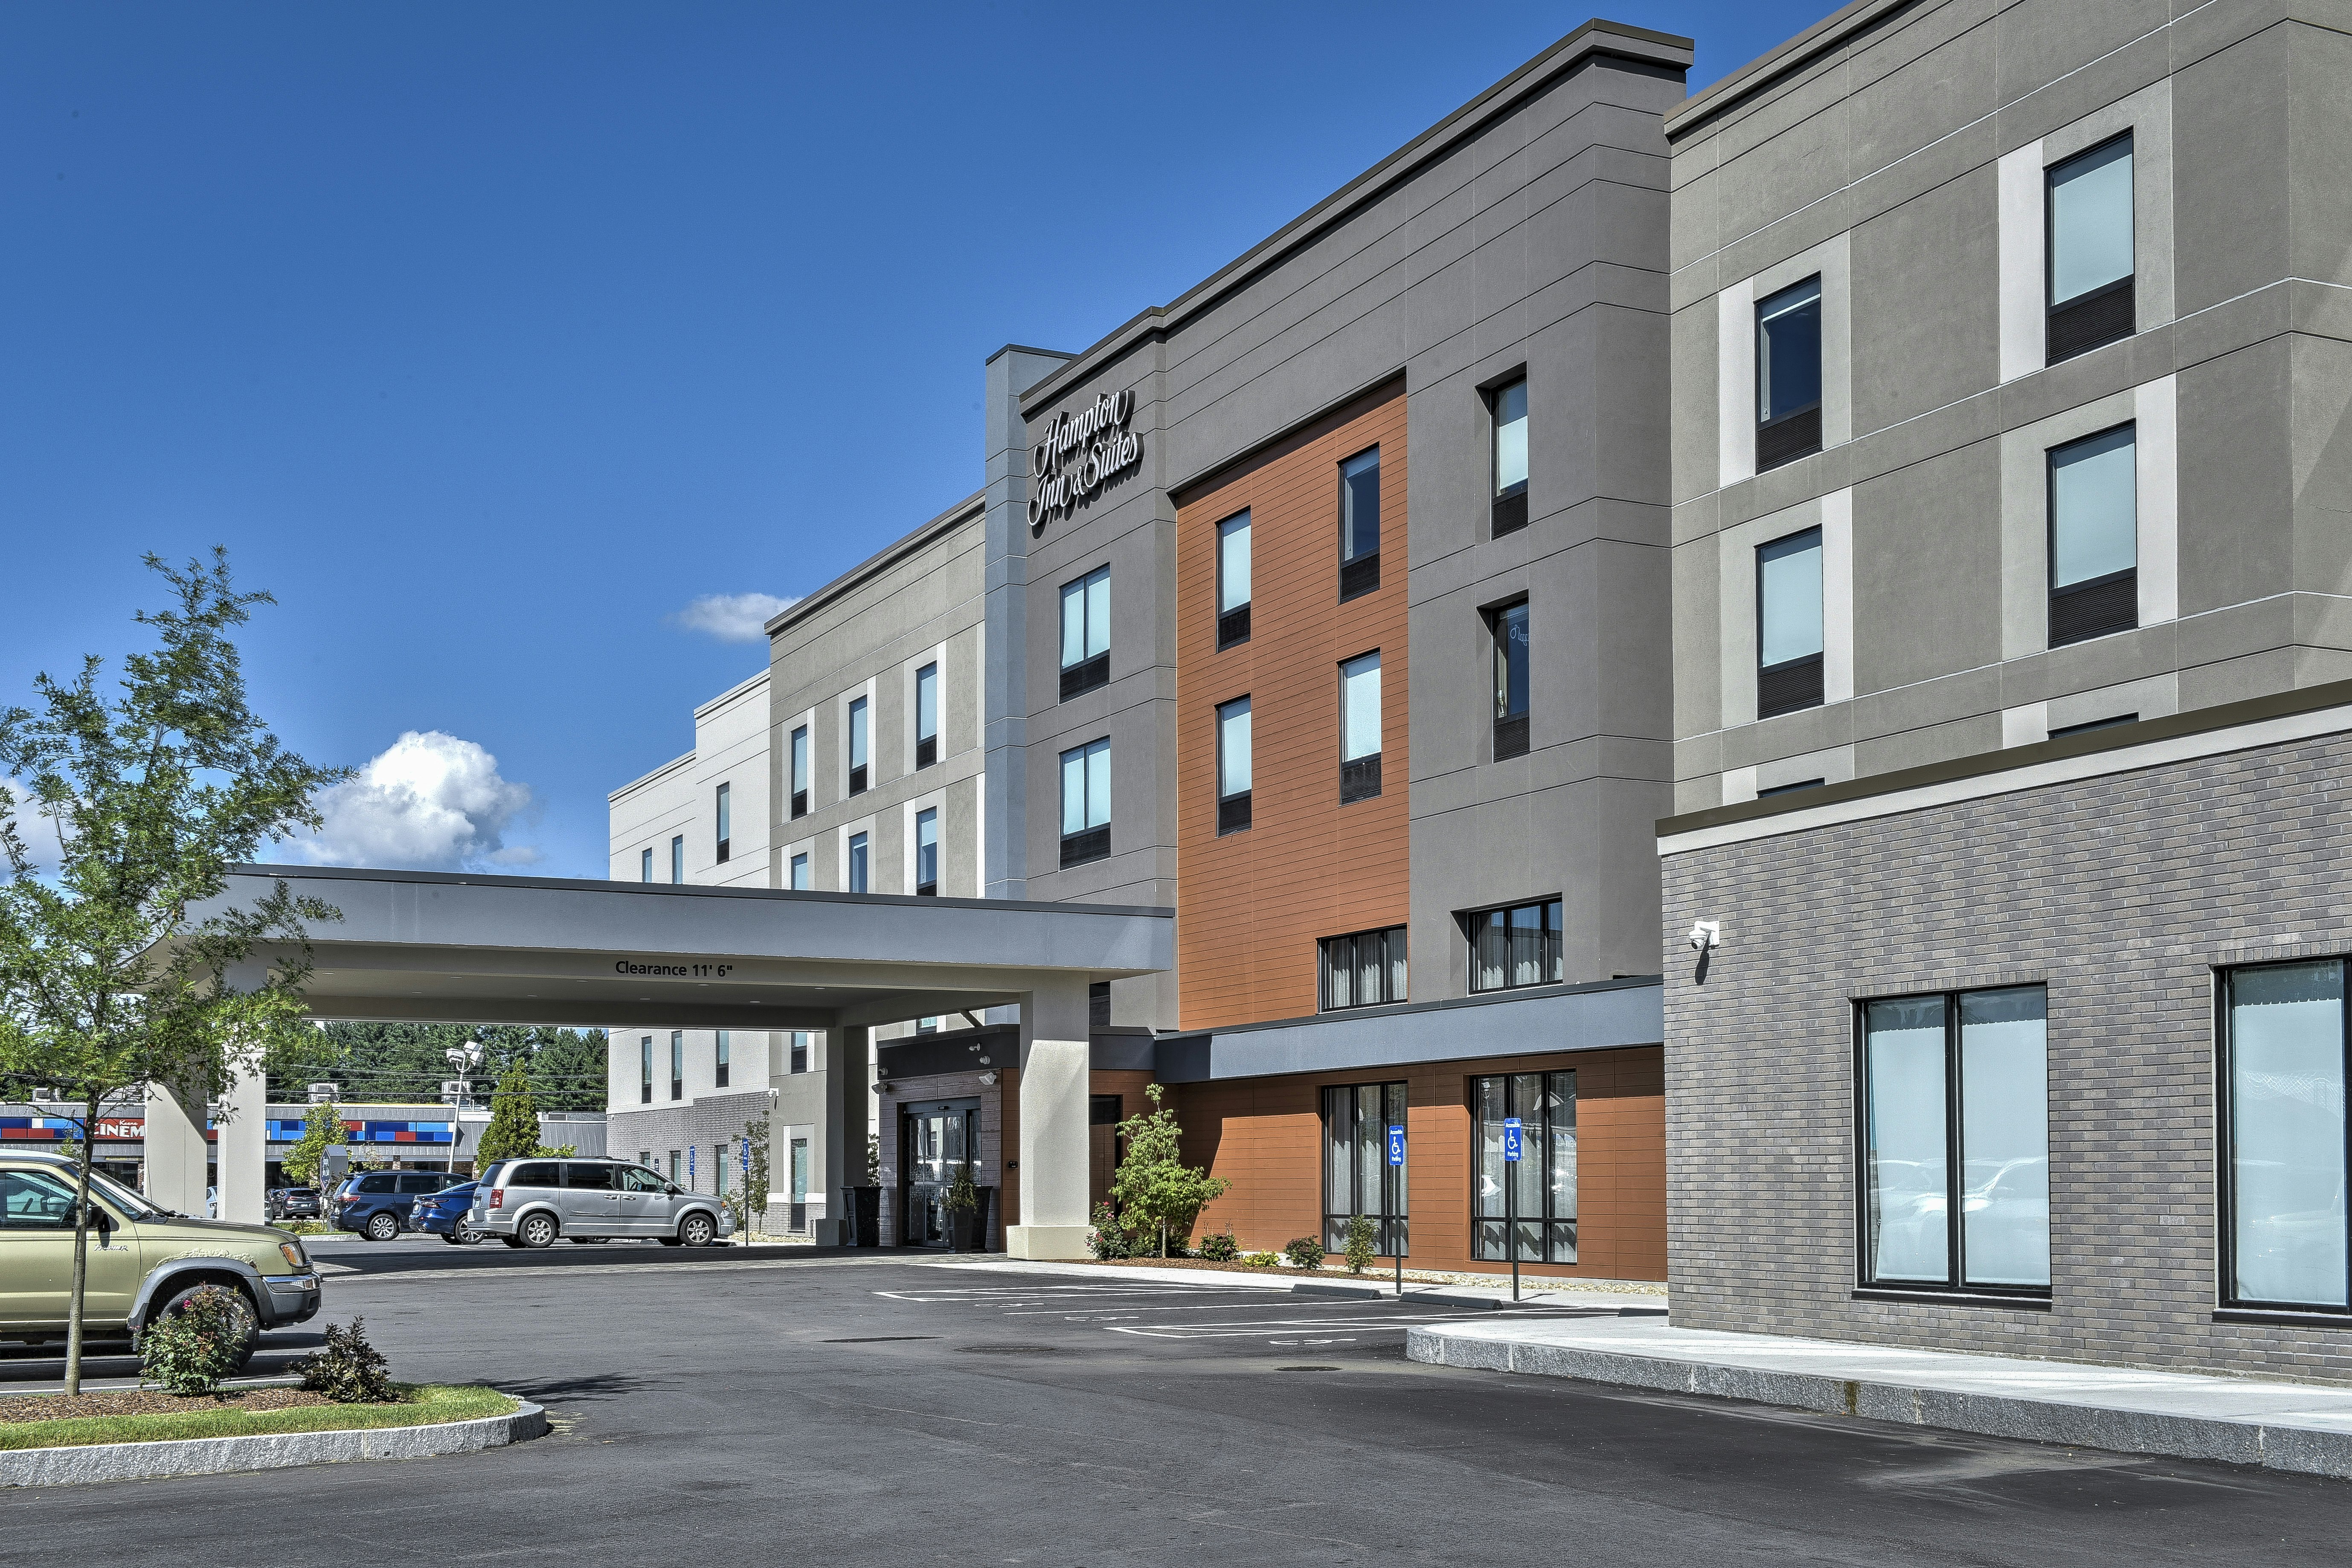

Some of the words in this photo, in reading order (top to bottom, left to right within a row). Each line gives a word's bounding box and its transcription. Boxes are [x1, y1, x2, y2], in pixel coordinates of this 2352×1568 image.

[1034, 389, 1132, 478] Hampton
[1027, 473, 1073, 526] Inn
[1073, 465, 1086, 496] &
[1084, 431, 1141, 488] Suites
[616, 961, 687, 976] Clearance
[692, 964, 713, 977] 11'
[717, 964, 733, 977] 6"
